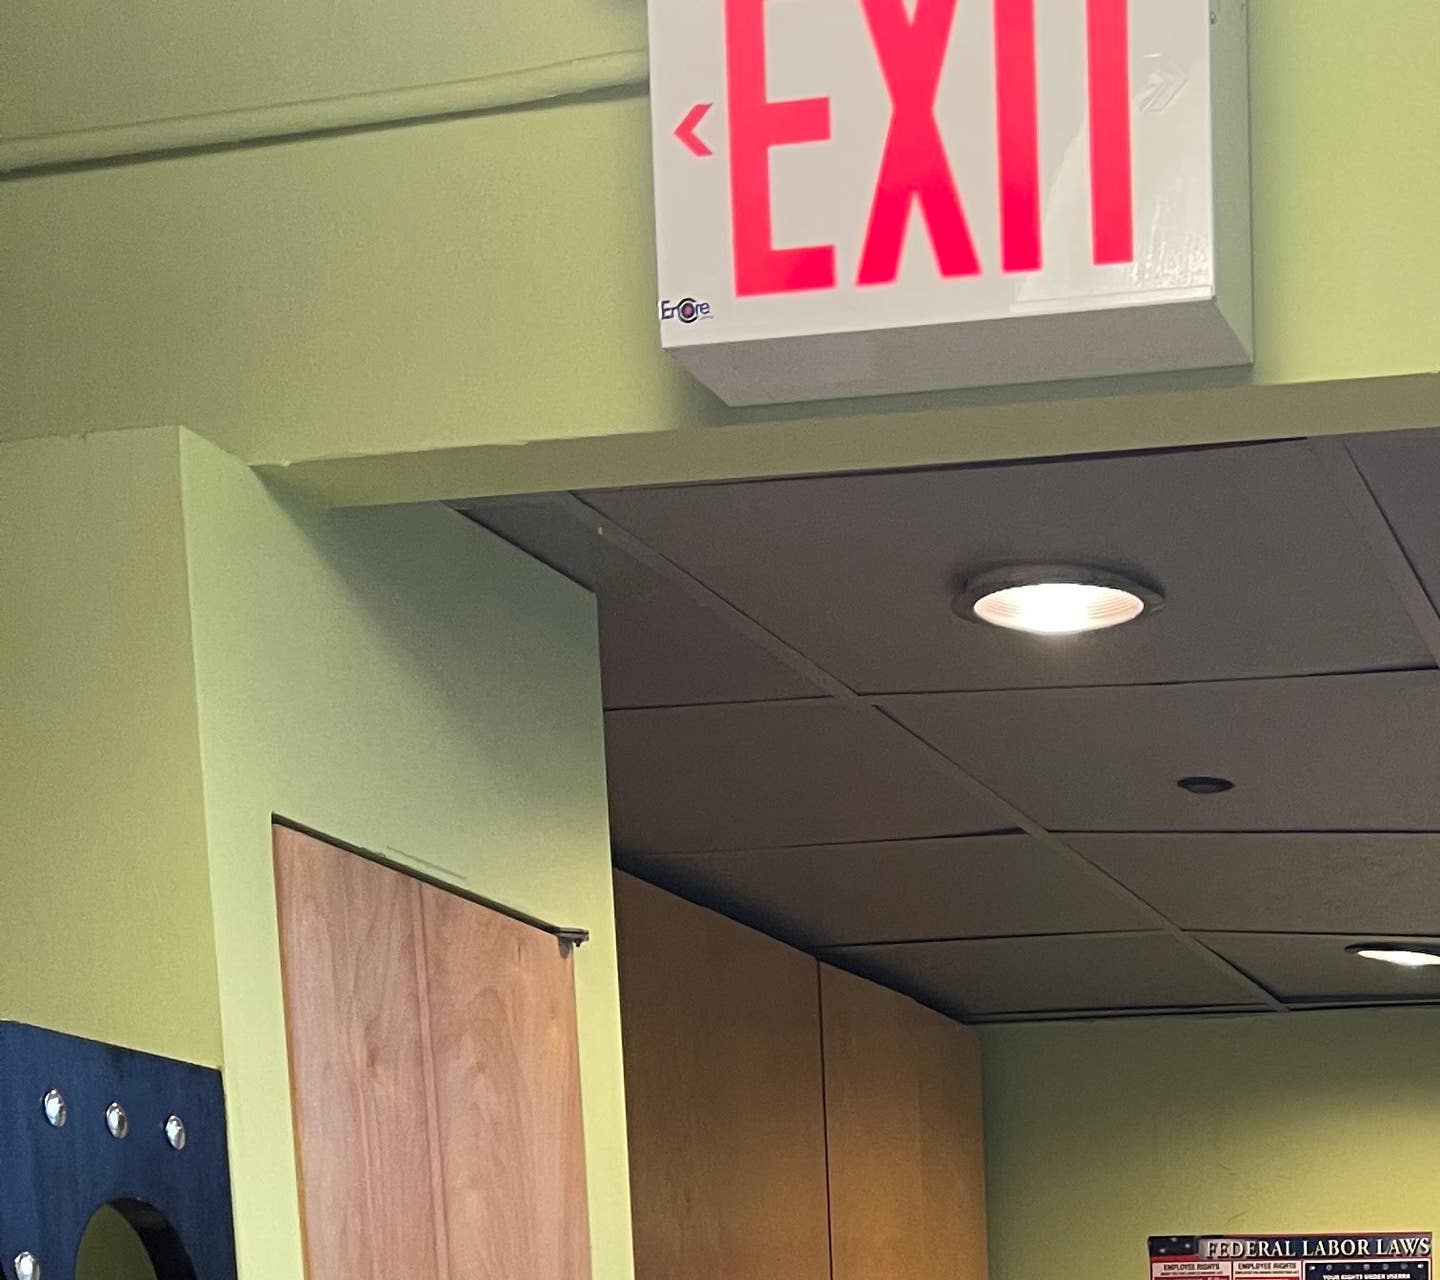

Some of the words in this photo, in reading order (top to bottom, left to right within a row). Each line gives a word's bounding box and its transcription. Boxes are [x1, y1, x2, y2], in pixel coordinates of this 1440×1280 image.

[1206, 1240, 1297, 1259] FEDERAL
[1302, 1238, 1371, 1257] LABOR
[1376, 1237, 1430, 1256] LAWS
